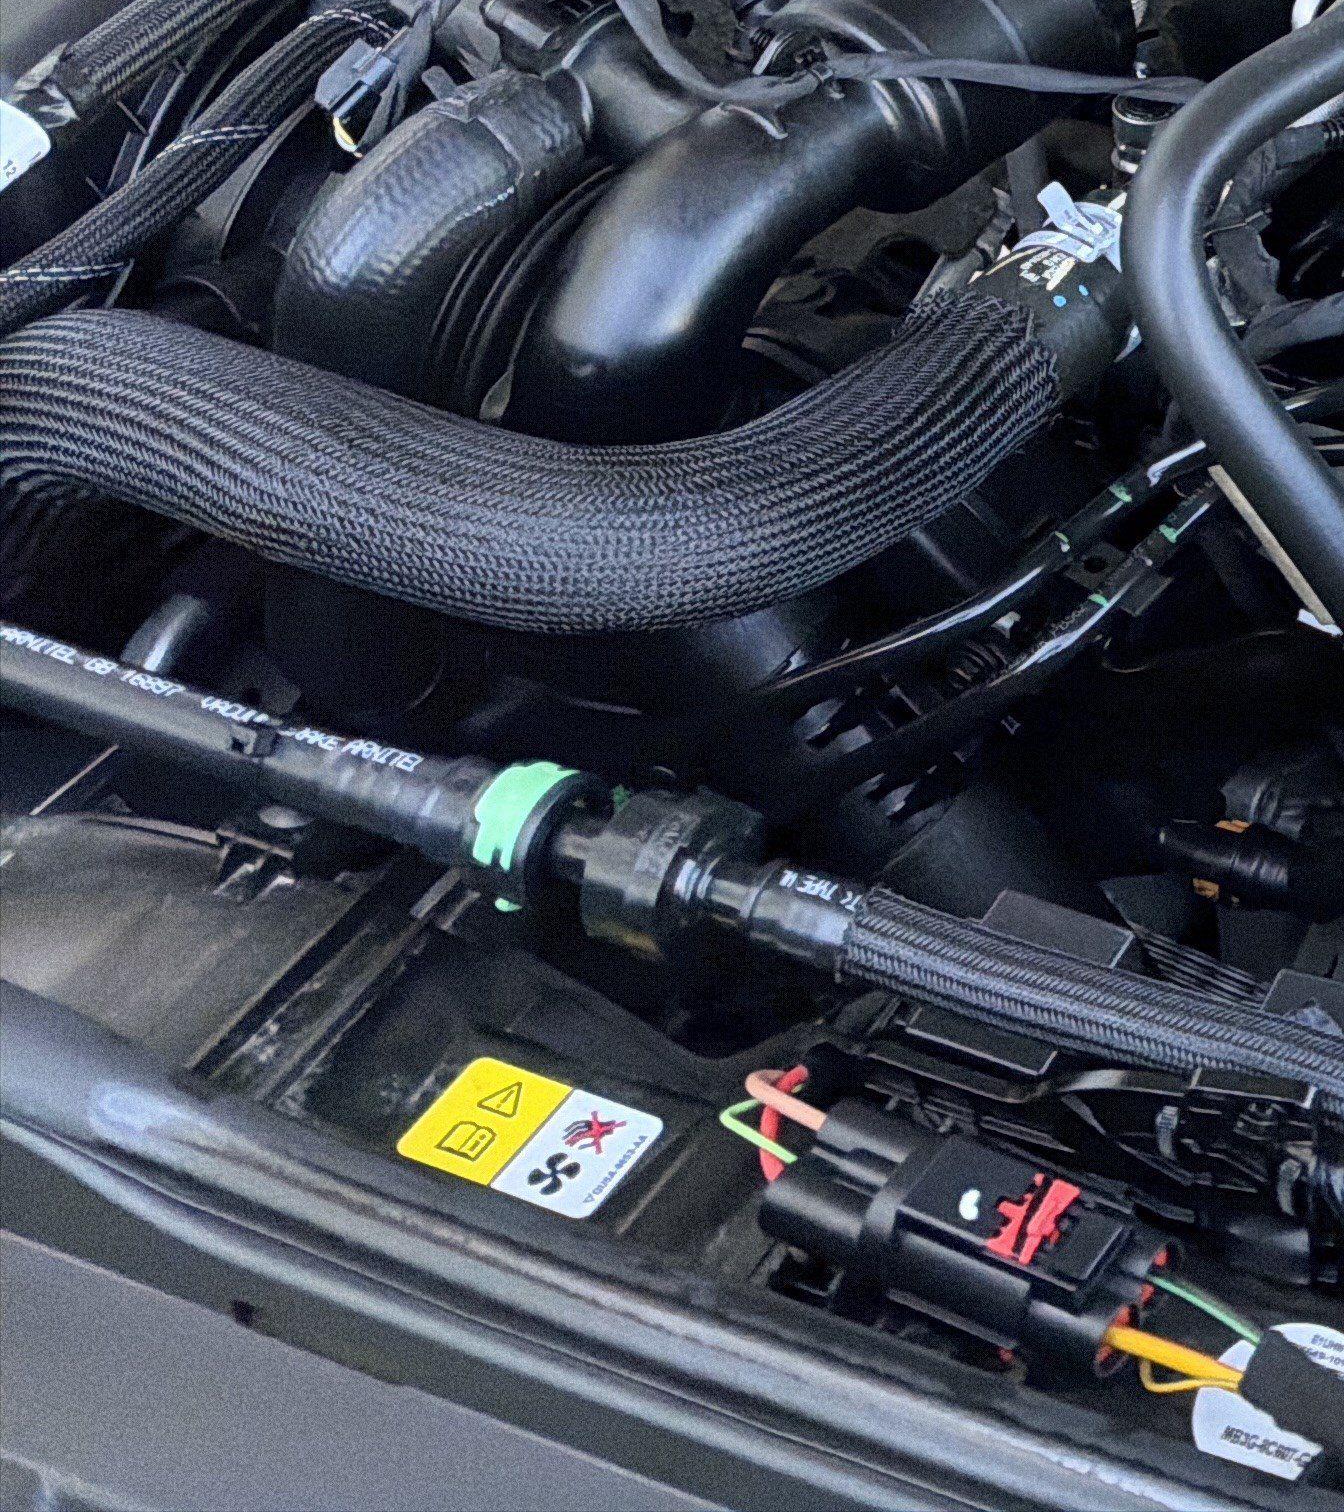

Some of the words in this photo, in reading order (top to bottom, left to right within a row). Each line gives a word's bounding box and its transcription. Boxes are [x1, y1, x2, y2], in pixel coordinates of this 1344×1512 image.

[0, 627, 77, 665] ARNITEL
[83, 657, 118, 675] GB
[340, 739, 424, 773] ARNITEL
